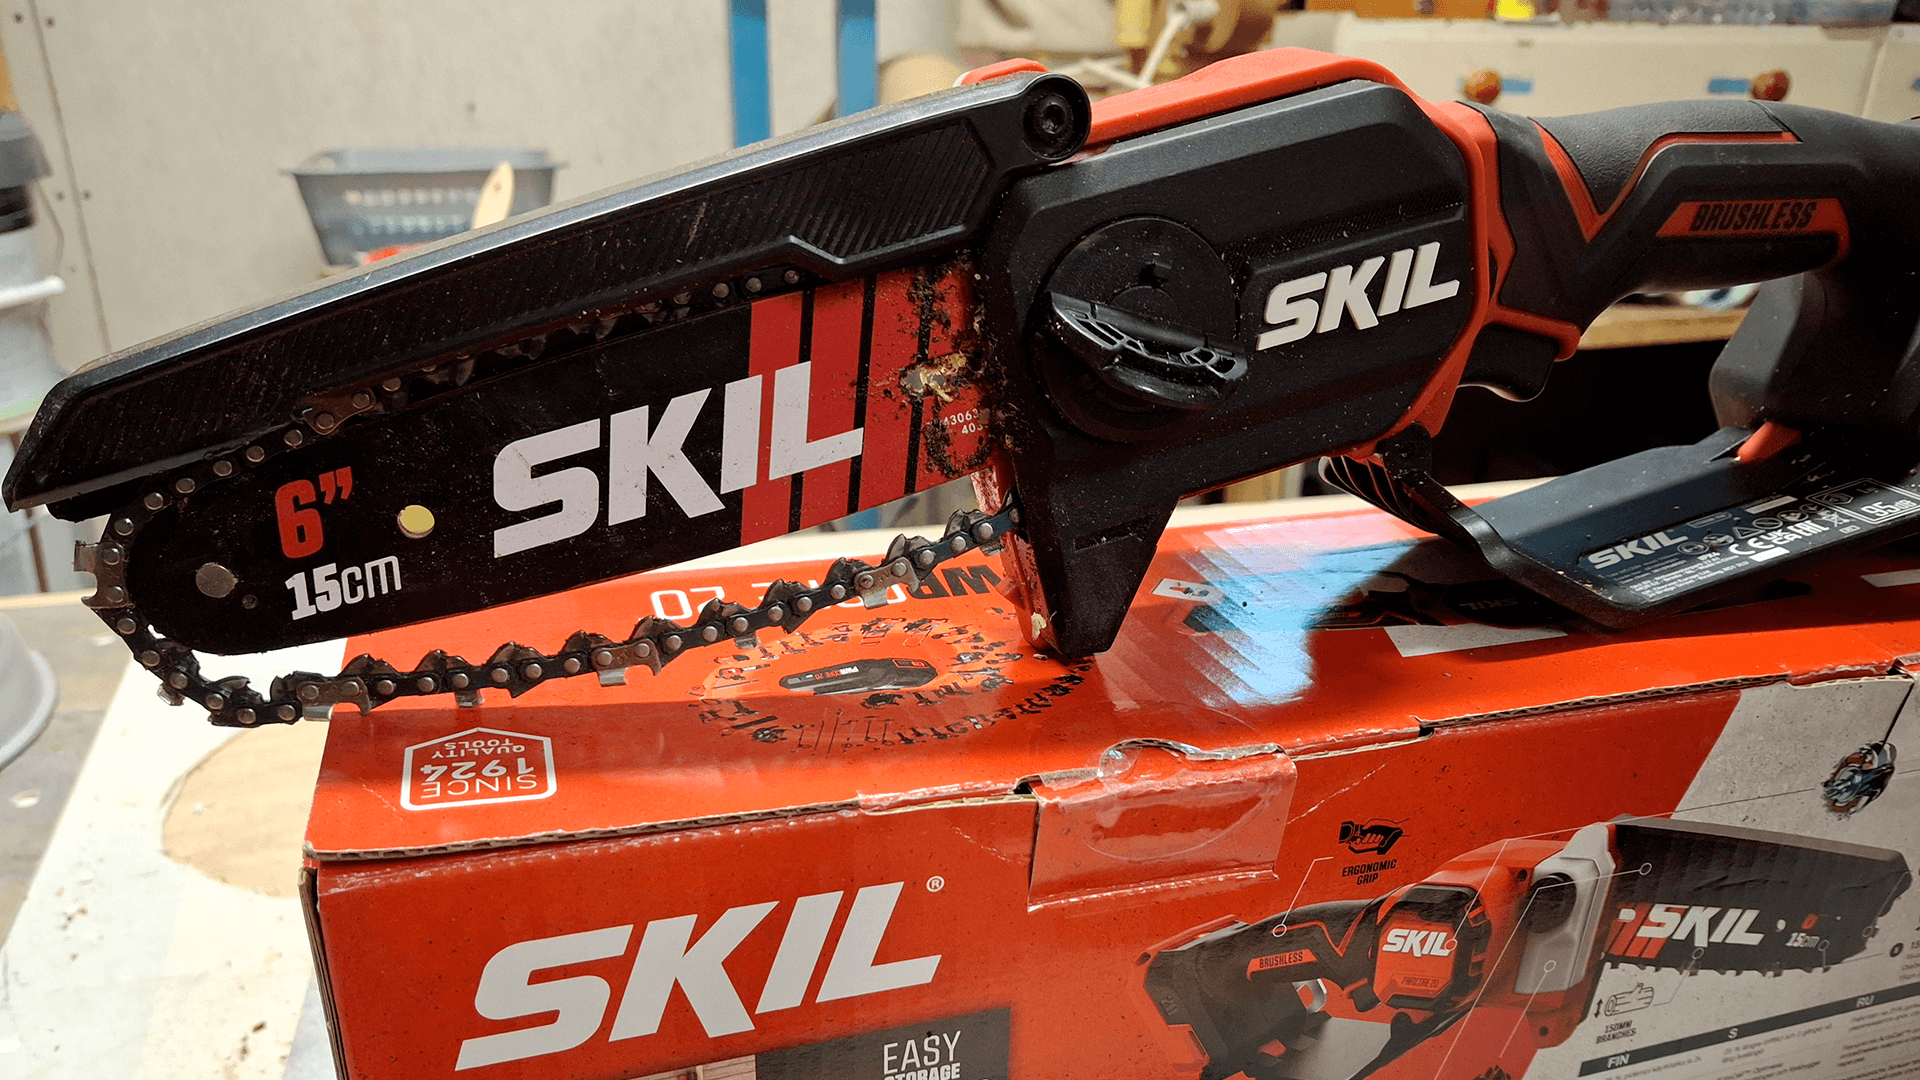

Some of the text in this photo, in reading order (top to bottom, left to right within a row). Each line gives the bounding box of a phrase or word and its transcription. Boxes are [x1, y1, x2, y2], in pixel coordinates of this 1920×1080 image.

[1690, 202, 1818, 231] BRUSHLESS
[1256, 241, 1460, 351] SKIL
[493, 361, 864, 558] SKIL
[1587, 531, 1689, 570] SKIL
[285, 555, 402, 621] 15cm
[431, 744, 526, 759] QUALITY
[444, 738, 514, 750] TOOLS
[420, 757, 535, 782] 1924
[420, 774, 537, 799] SINCE
[1342, 859, 1398, 877] ERGONOMIC
[1356, 873, 1379, 885] GRIP
[1636, 903, 1765, 947] SKIL
[1382, 928, 1452, 957] SKIL
[1259, 951, 1304, 969] BRUSHLESS
[455, 881, 942, 1071] SKIL
[1855, 994, 1875, 1009] RU
[1595, 1028, 1637, 1045] BRANCHES
[1727, 1027, 1739, 1040] S
[883, 1030, 961, 1075] EASY
[1606, 1053, 1631, 1069] FIN
[884, 1062, 961, 1080] ORAGE
